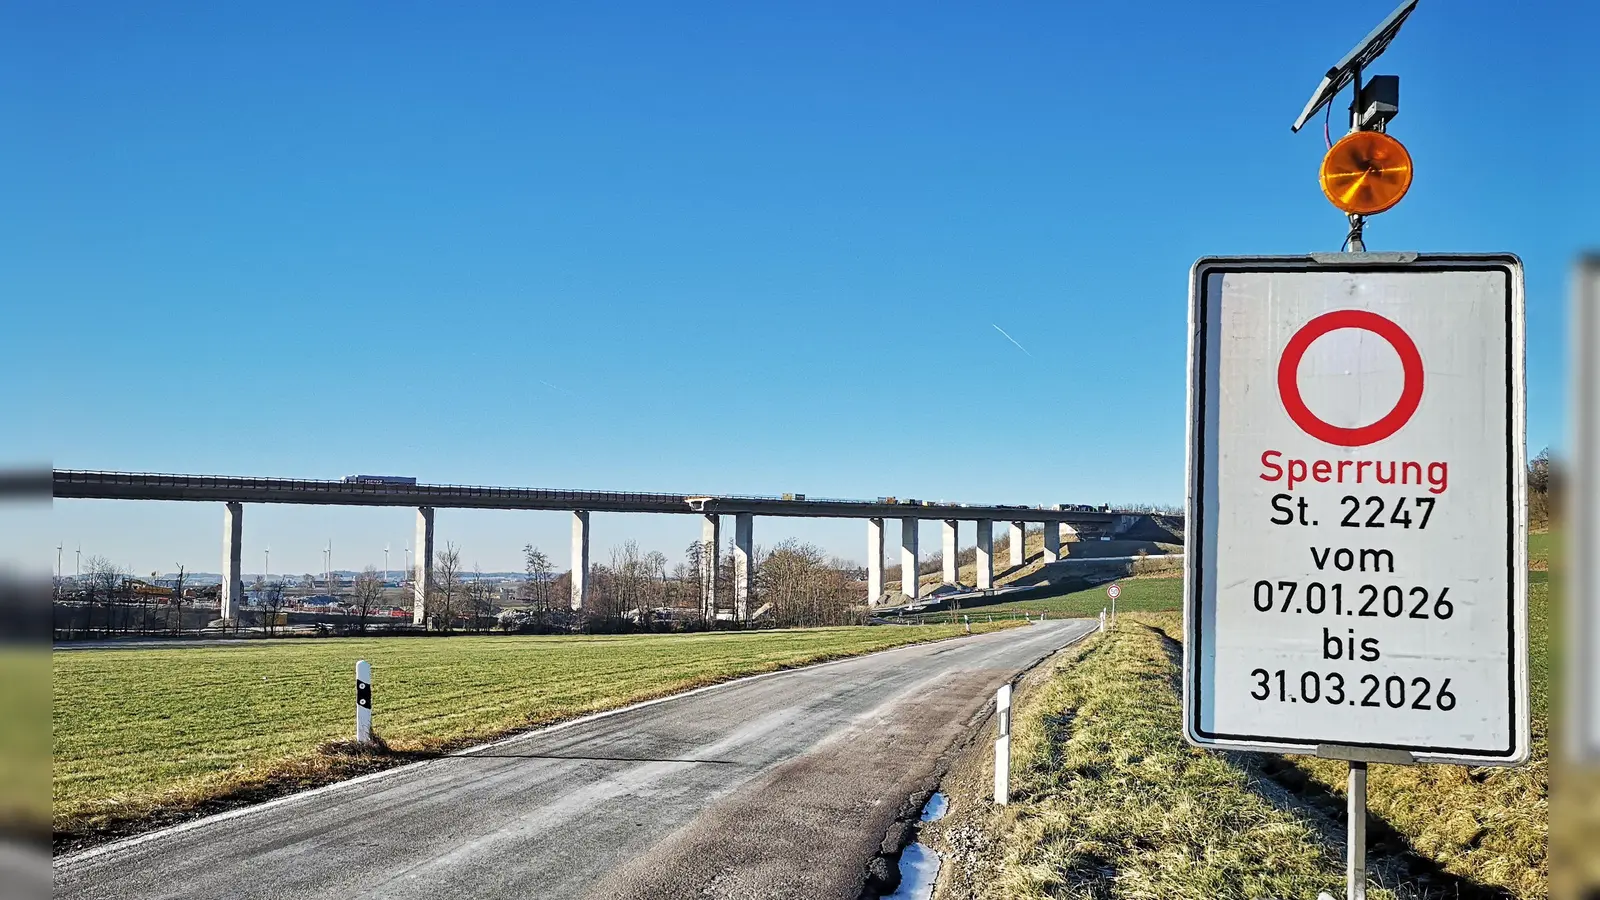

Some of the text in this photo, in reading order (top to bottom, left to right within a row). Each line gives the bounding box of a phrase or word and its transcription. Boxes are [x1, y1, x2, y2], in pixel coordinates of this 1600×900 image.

[1260, 450, 1449, 494] Sperrung
[1270, 494, 1436, 530] St. 2247
[1309, 546, 1395, 573] vom
[1253, 580, 1454, 620] 07.01.2026
[1322, 627, 1381, 662] bis
[1250, 668, 1457, 711] 31.03.2026
